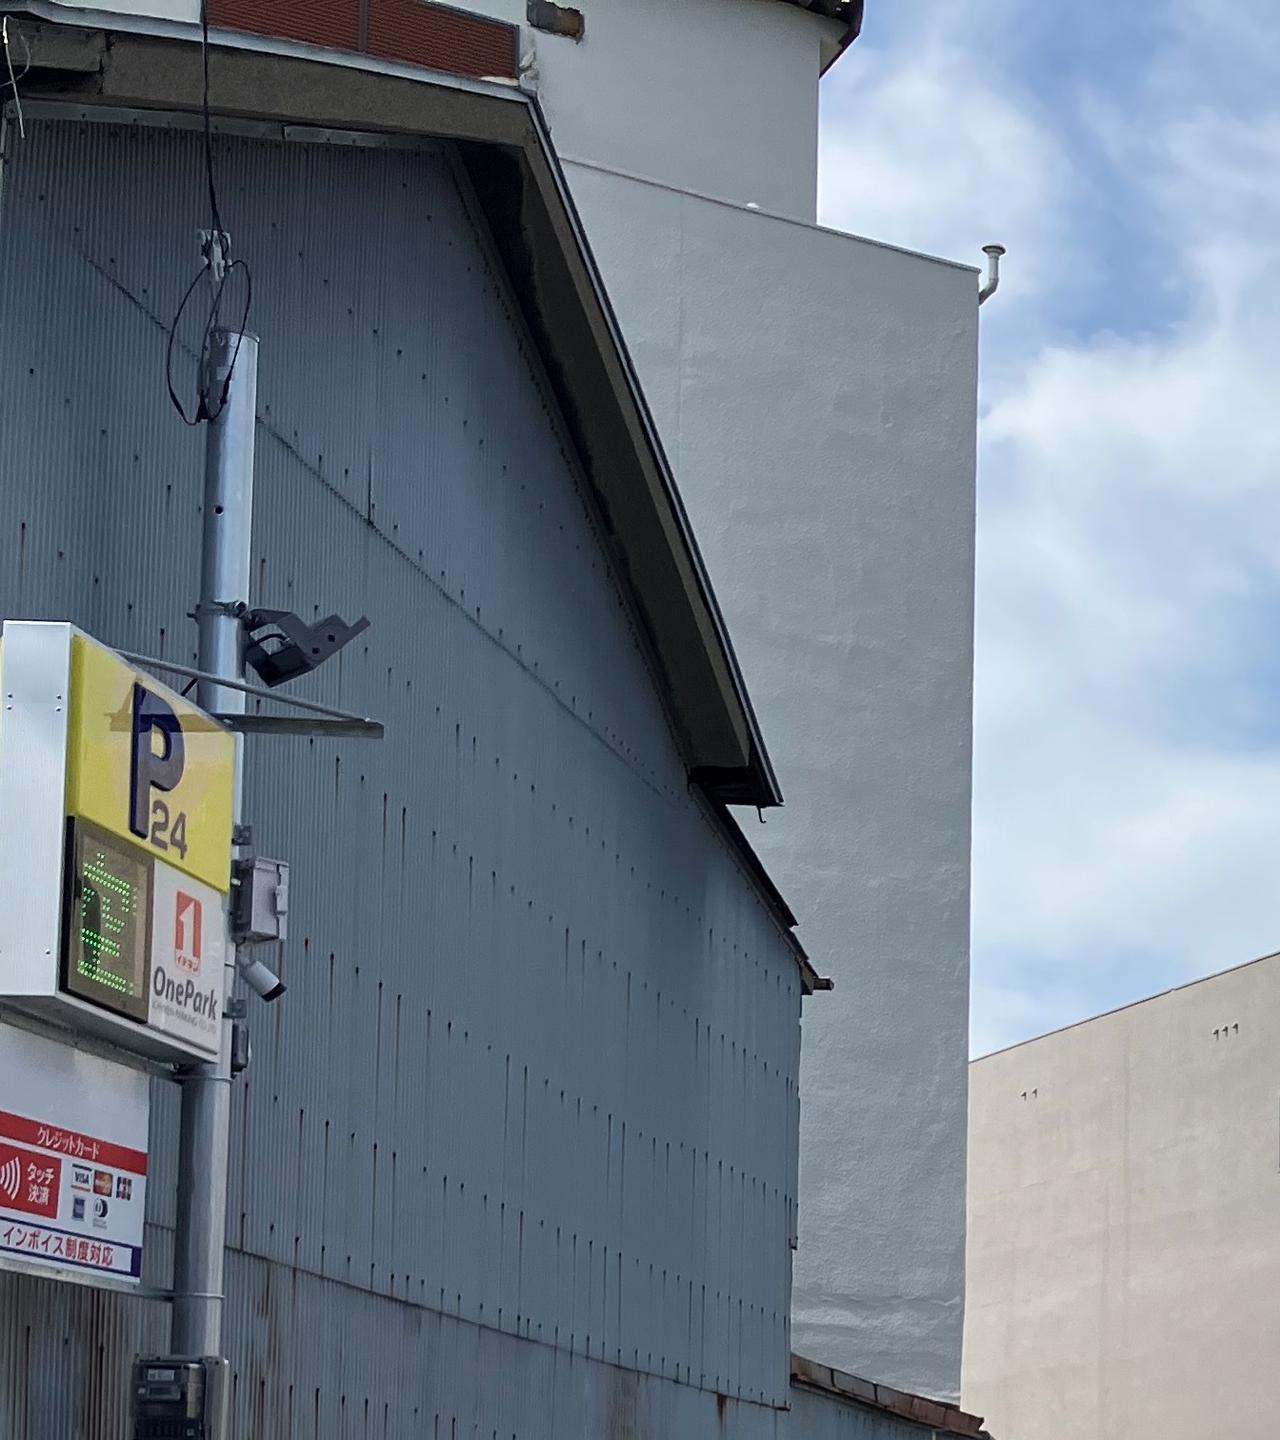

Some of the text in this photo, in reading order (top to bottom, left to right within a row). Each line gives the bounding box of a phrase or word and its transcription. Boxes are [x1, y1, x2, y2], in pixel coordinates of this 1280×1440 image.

[128, 680, 187, 840] P
[149, 799, 188, 860] 24
[153, 965, 218, 1021] OnePark
[37, 1126, 100, 1160] クレジットカード
[27, 1162, 55, 1185] タッチ
[74, 1171, 90, 1186] VISA
[28, 1183, 50, 1206] 決済
[3, 1225, 114, 1267] インボイス制度対応
